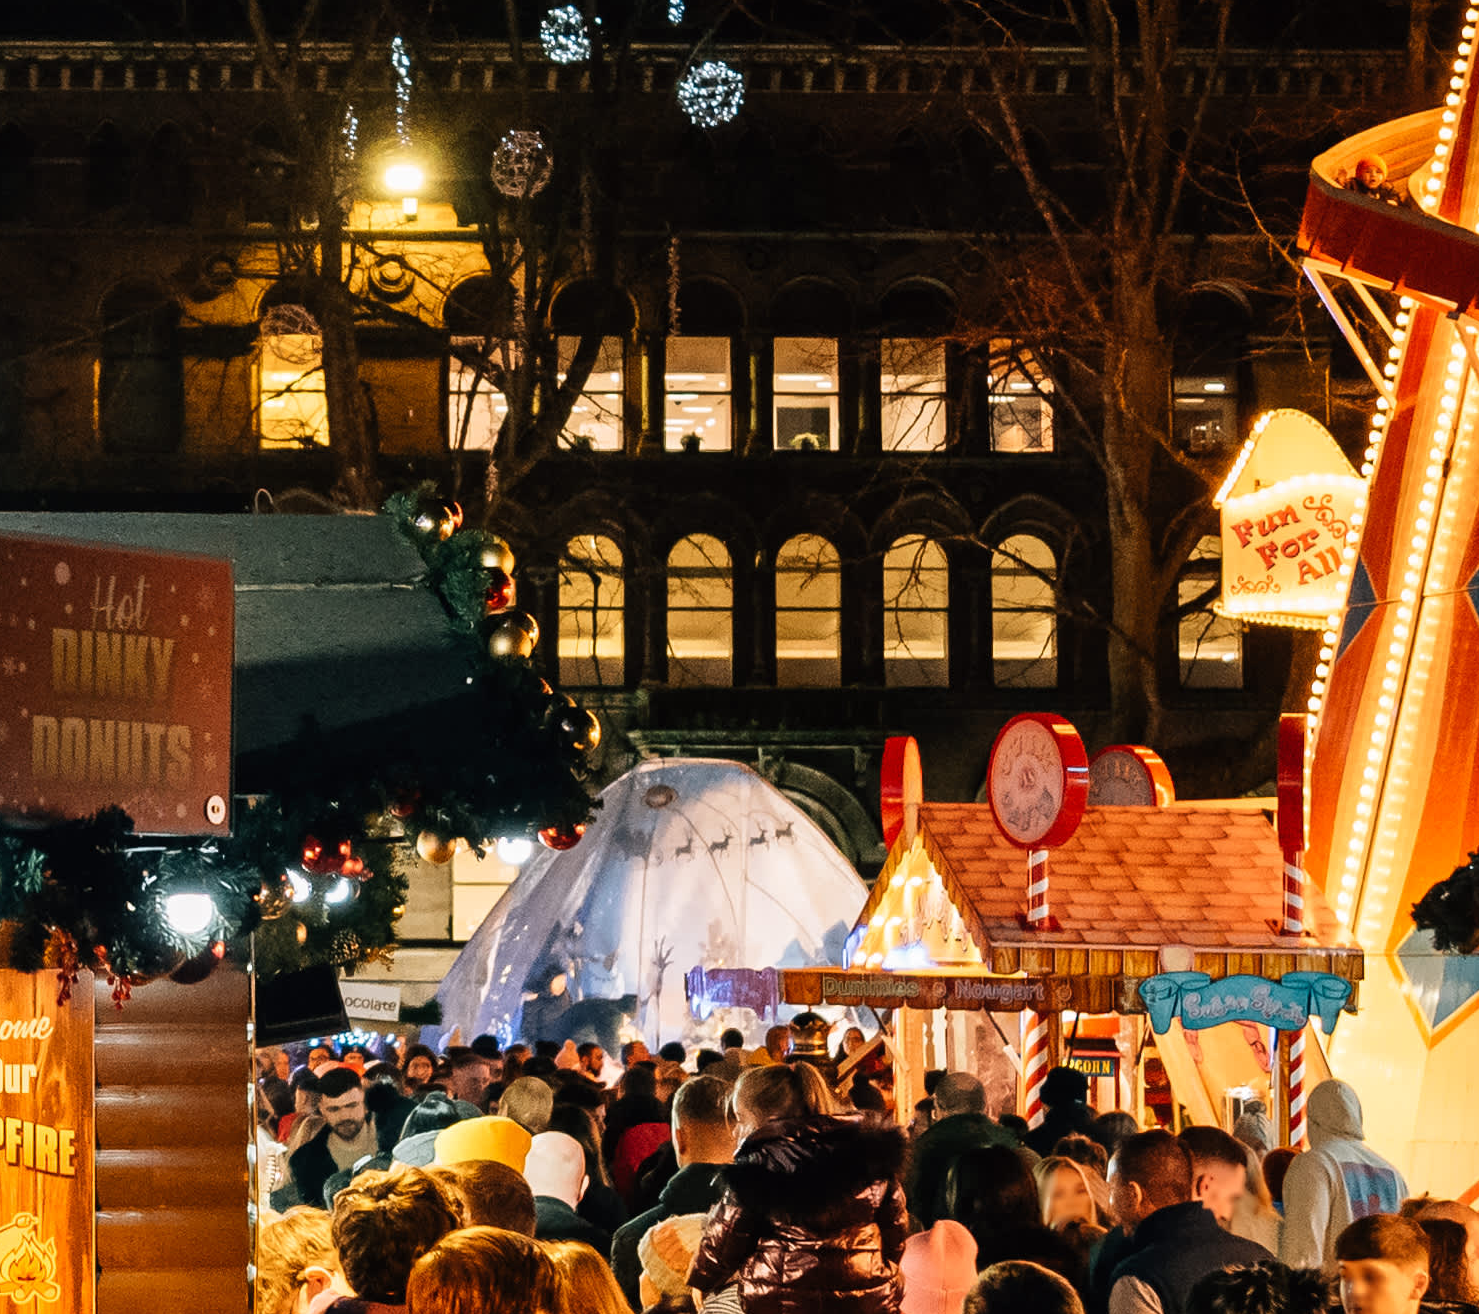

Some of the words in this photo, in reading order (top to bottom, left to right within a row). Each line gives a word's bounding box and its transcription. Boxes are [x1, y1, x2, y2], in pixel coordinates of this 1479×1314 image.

[1231, 503, 1301, 549] Fun
[1256, 529, 1320, 571] For
[1298, 547, 1343, 587] All
[89, 575, 150, 630] Hot
[51, 628, 175, 699] DINKY
[31, 716, 191, 782] DONUTS
[345, 997, 396, 1011] ocolate
[824, 977, 919, 998] Dummies
[955, 980, 1045, 1004] Nougart
